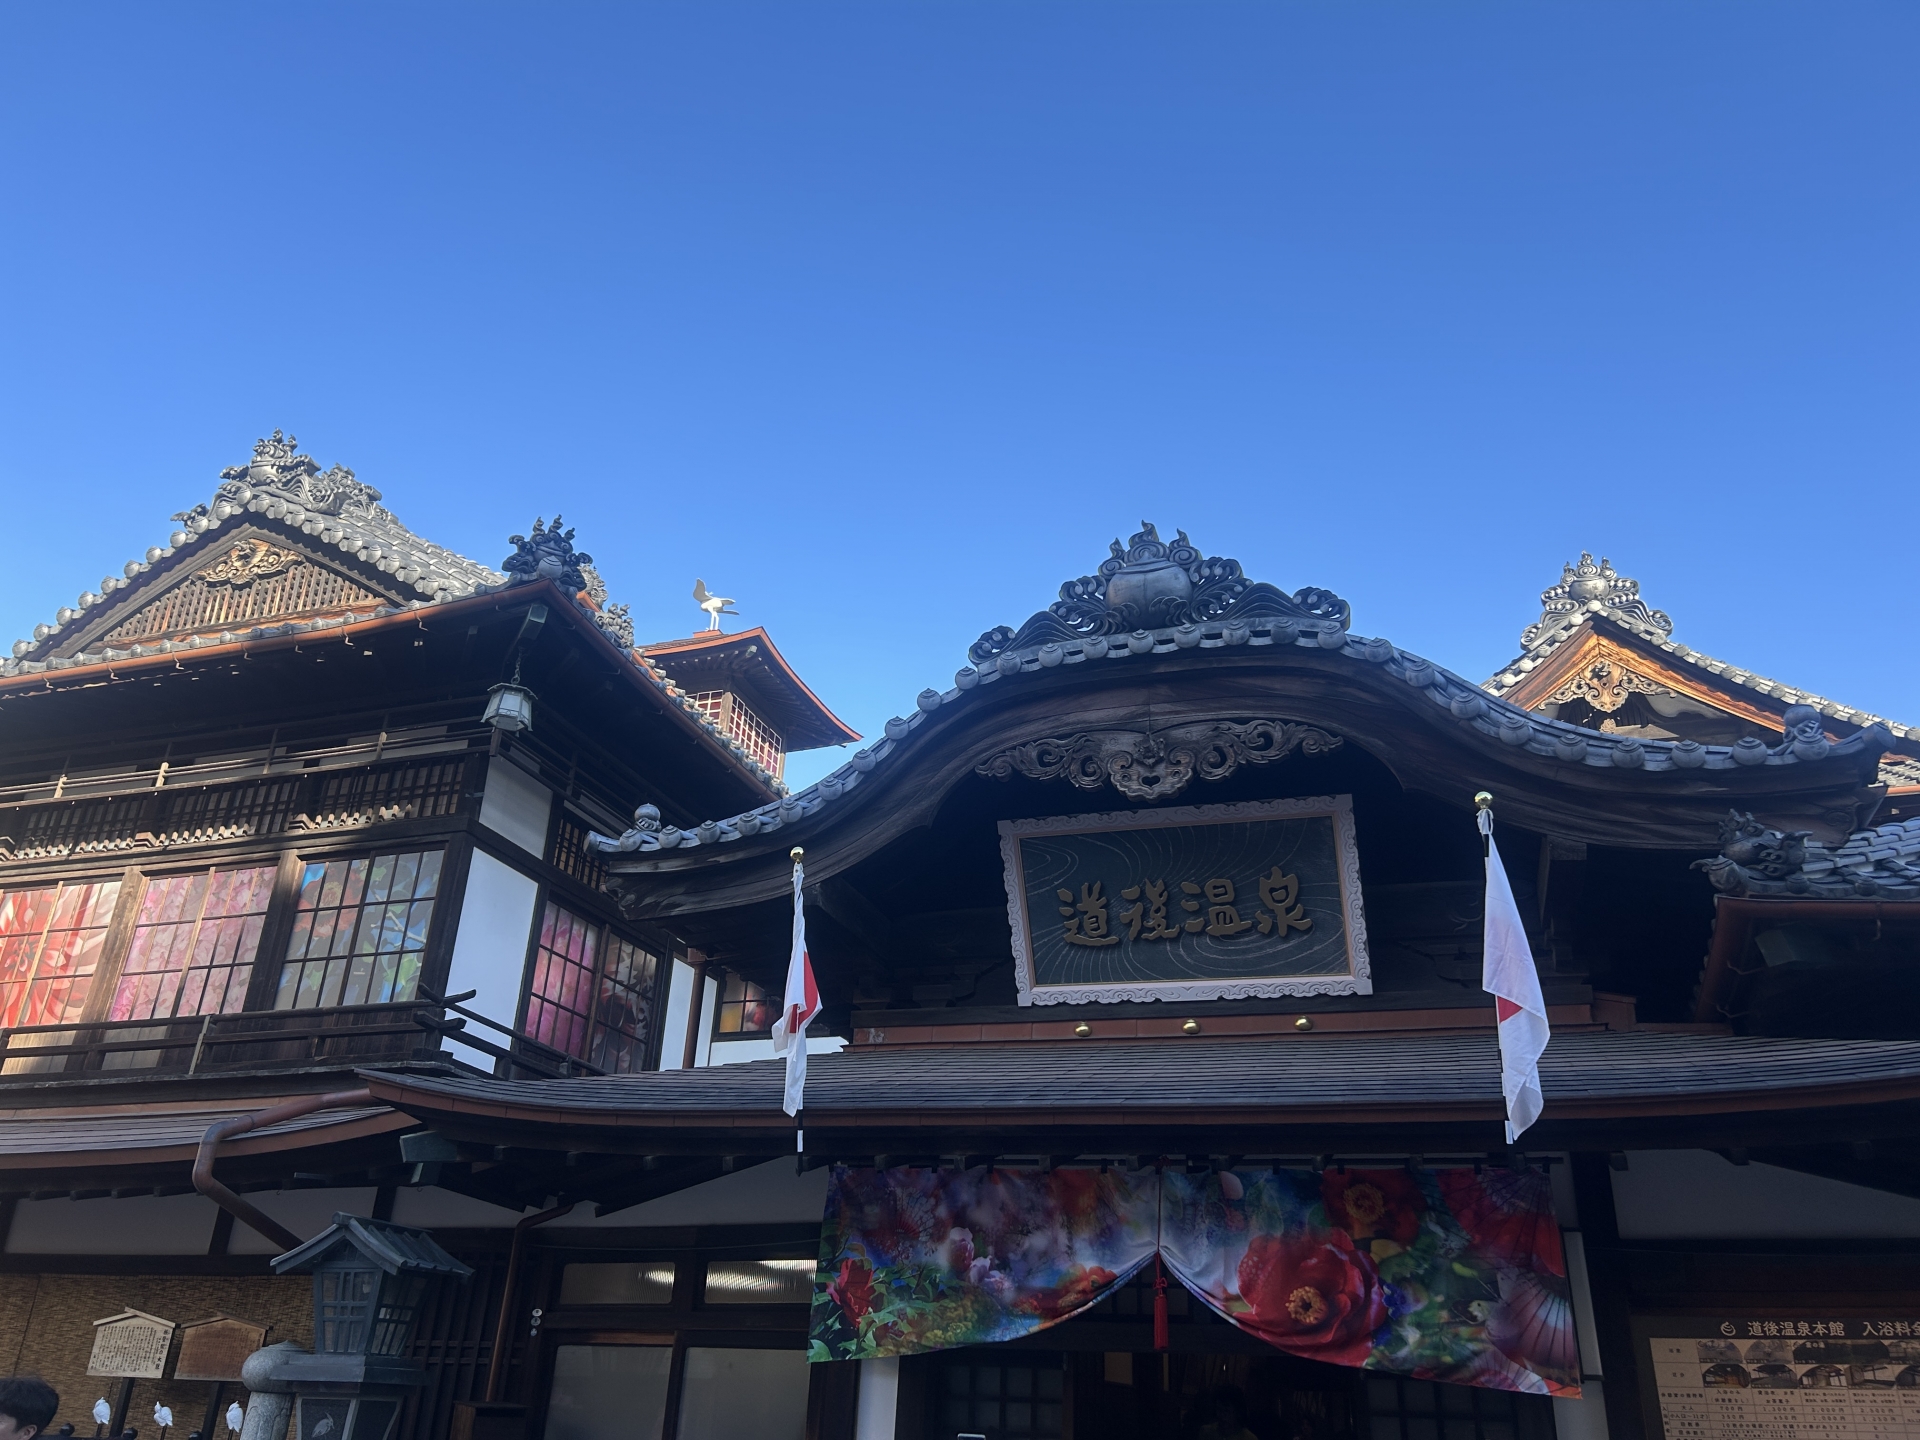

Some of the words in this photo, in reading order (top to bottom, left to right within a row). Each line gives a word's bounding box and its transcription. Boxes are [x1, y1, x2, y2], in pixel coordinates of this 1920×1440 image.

[1057, 866, 1313, 947] 道後温泉
[1747, 1321, 1845, 1337] 道後温泉本館
